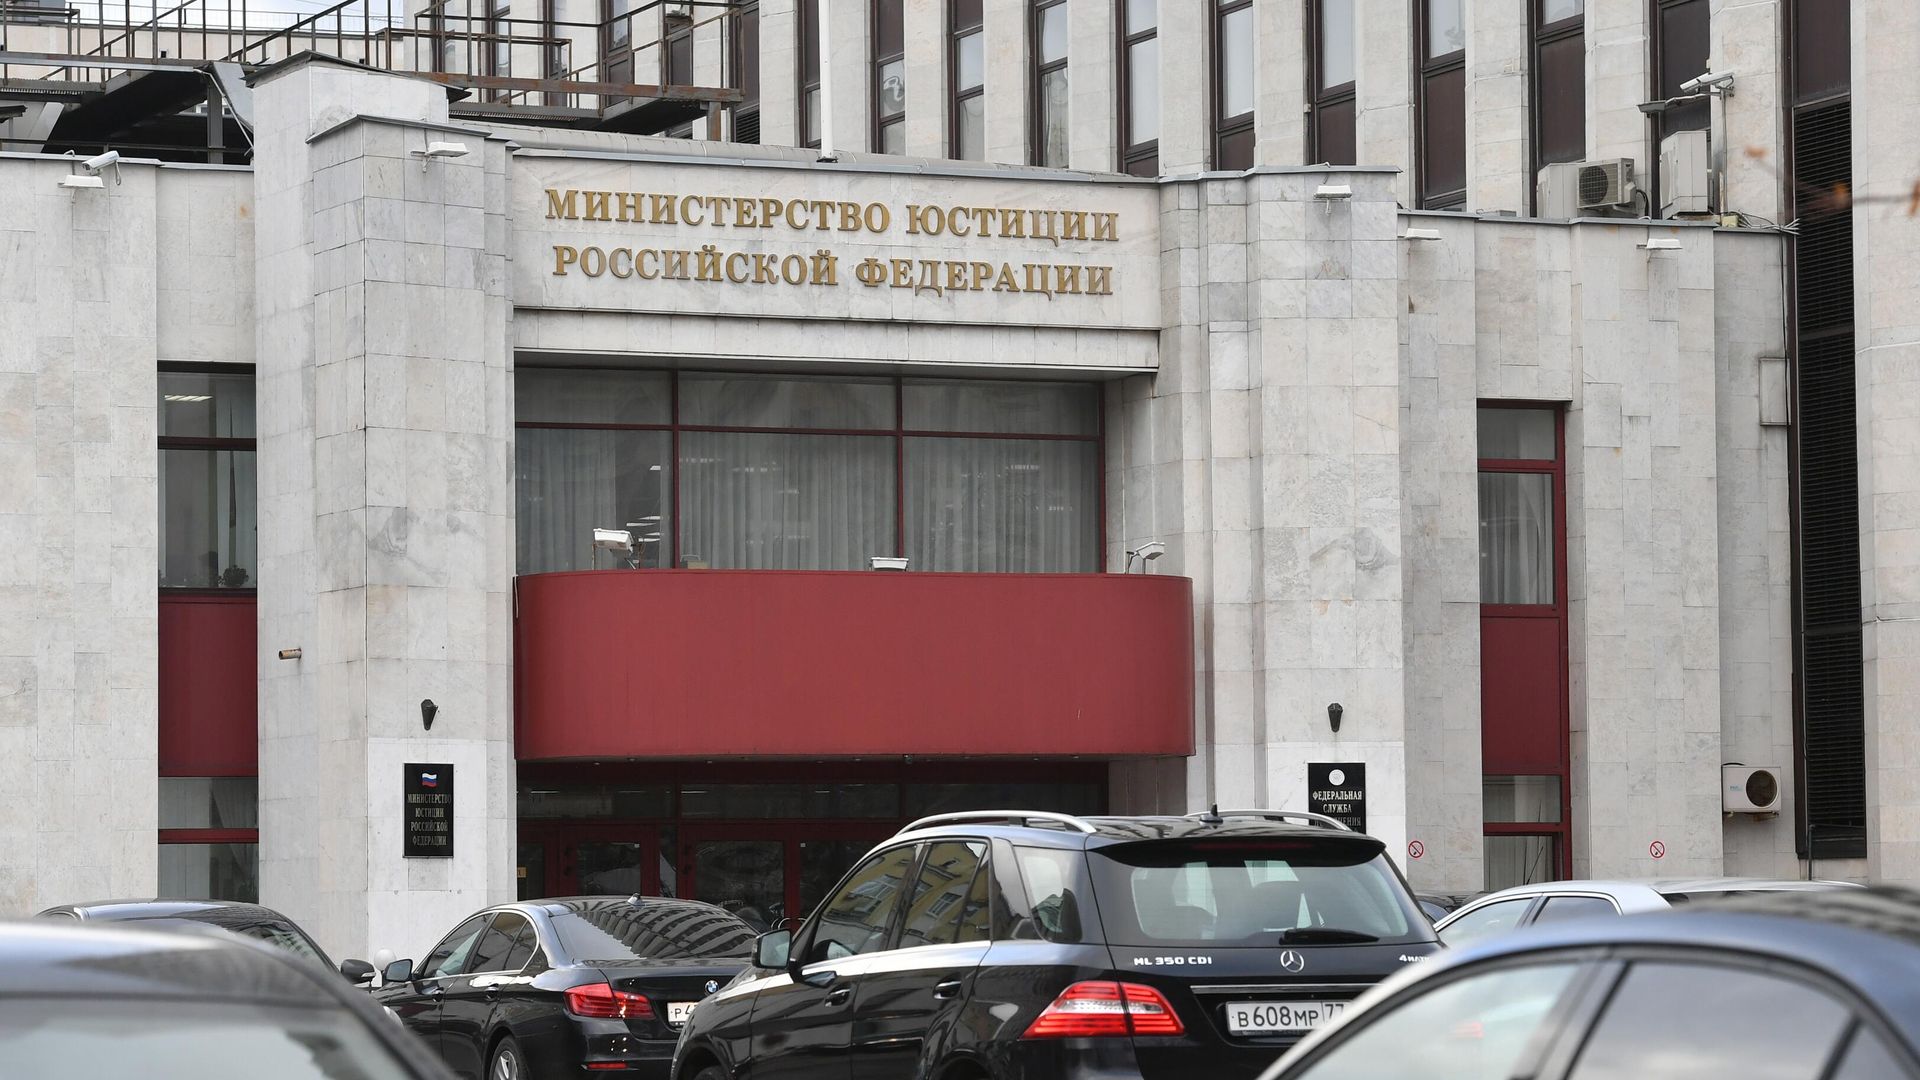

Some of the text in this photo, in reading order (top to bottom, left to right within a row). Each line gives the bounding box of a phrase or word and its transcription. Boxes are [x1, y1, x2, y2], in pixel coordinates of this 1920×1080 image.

[545, 188, 1120, 248] МИНИСТЕРСТВО ЮСТИЦИИ
[552, 244, 1114, 301] РОССИЙСКОЙ ФЕДЕРАЦИИ
[407, 793, 452, 804] МИНИСТЕРСТВО
[1312, 790, 1362, 802] ФЕДЕРАЛЬНАЯ
[415, 807, 444, 818] ЮСТИЦИИ
[1322, 803, 1352, 813] СЛУЖБА
[410, 820, 448, 832] РОССИЙСКОЙ
[412, 835, 447, 847] ФЕДЕРАЦИИ
[1133, 956, 1213, 966] ML 350 CDI
